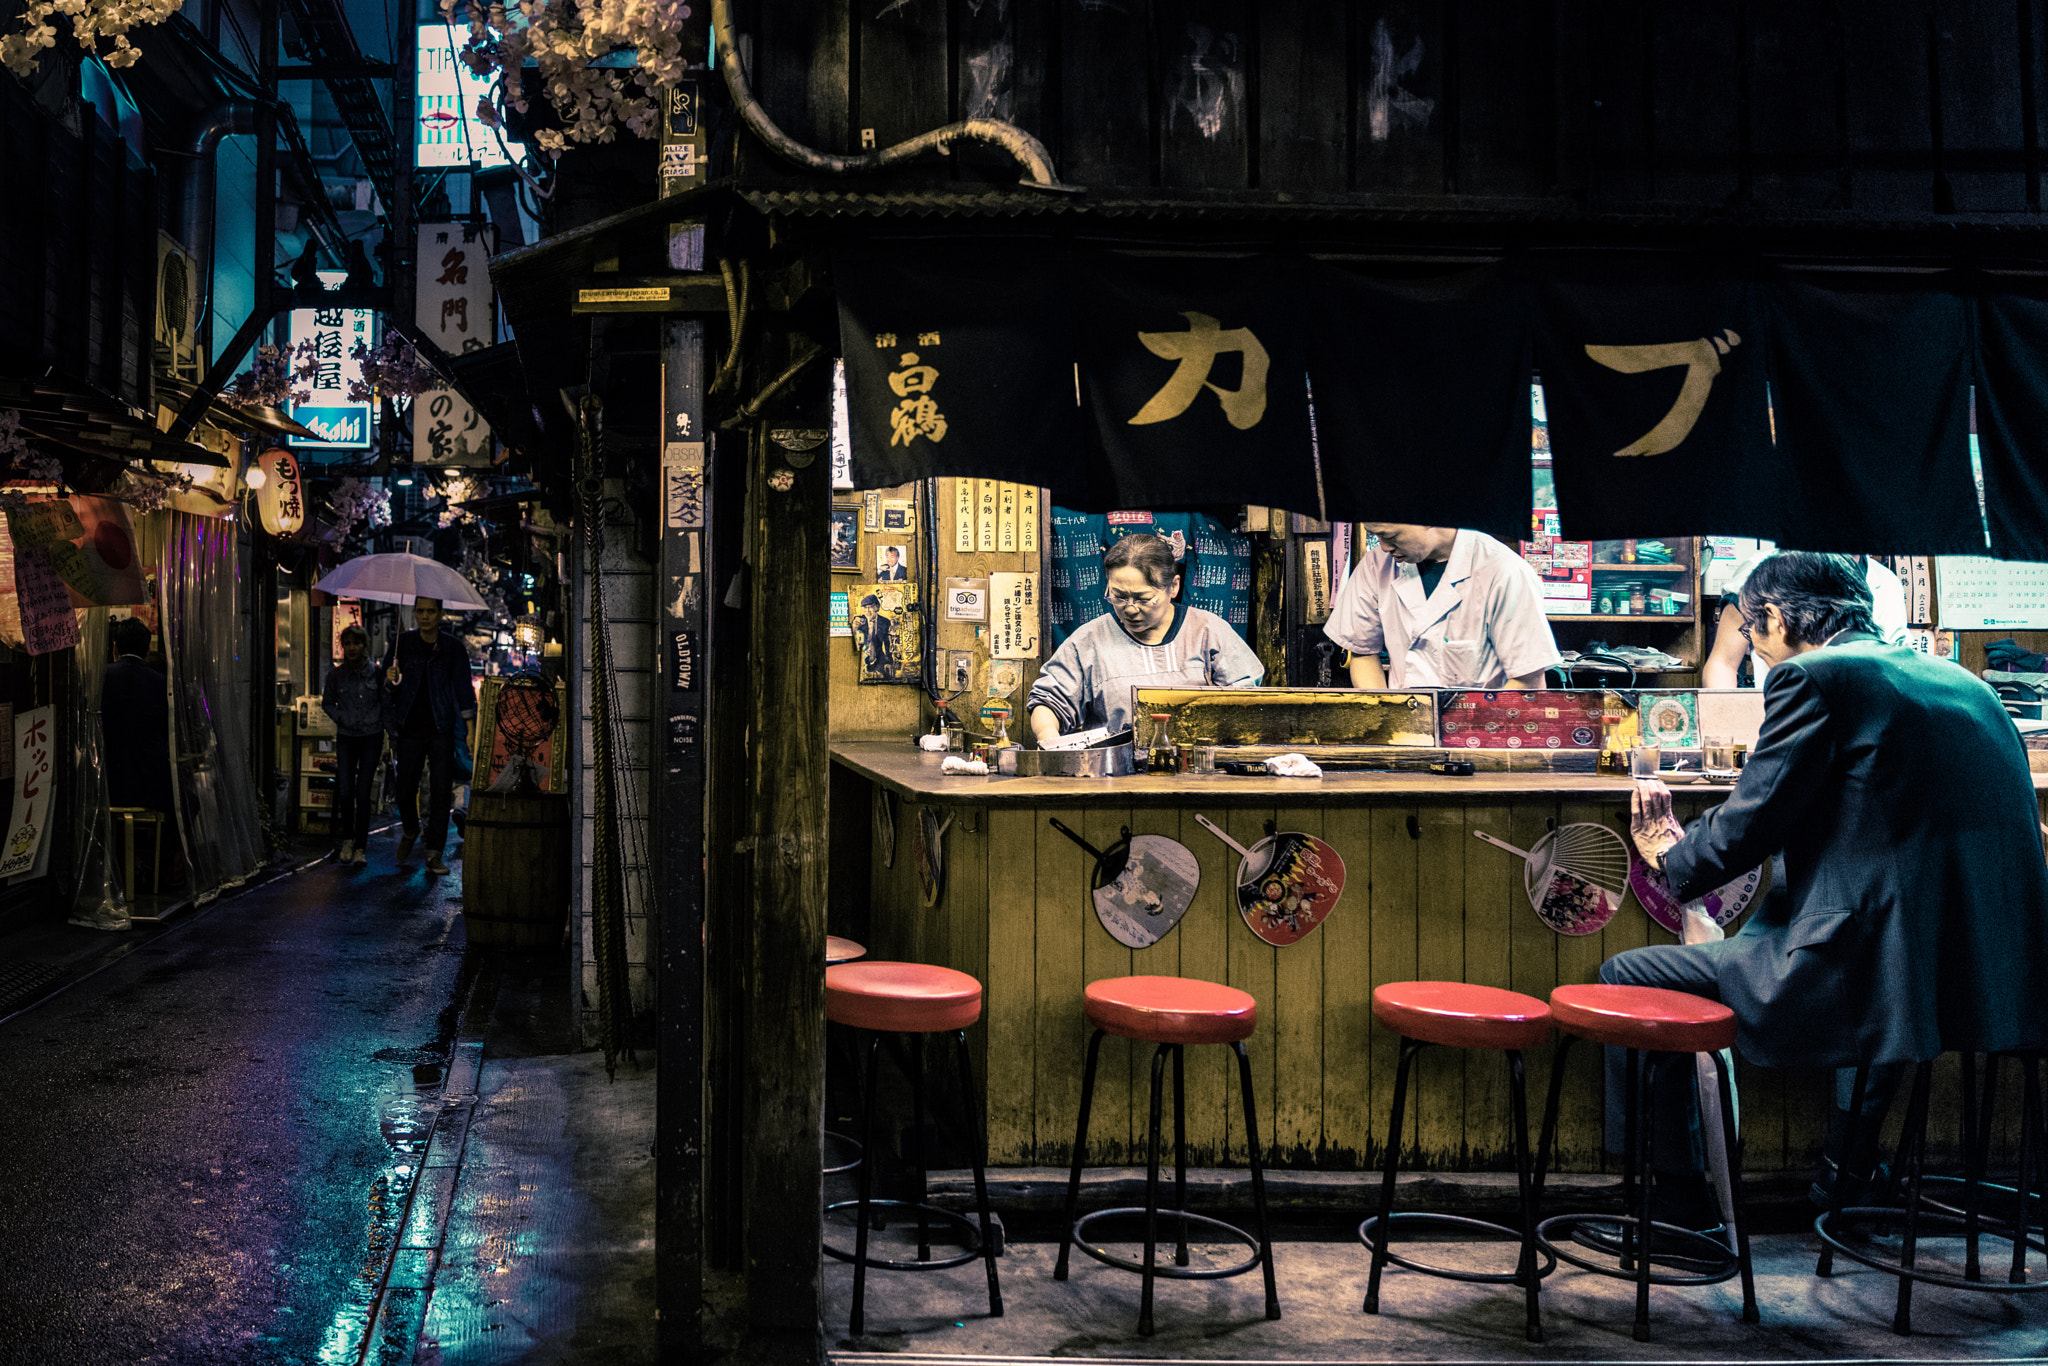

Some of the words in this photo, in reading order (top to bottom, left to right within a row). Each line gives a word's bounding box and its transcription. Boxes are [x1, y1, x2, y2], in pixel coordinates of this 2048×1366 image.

[436, 247, 469, 333] 名門
[888, 352, 948, 448] 白鶴
[274, 457, 301, 519] もつ焼
[1112, 511, 1146, 522] 2016
[675, 633, 693, 690] OLDTOWN
[673, 735, 695, 744] NOISE
[1603, 708, 1629, 717] KIRIN
[23, 715, 49, 825] ホッピー
